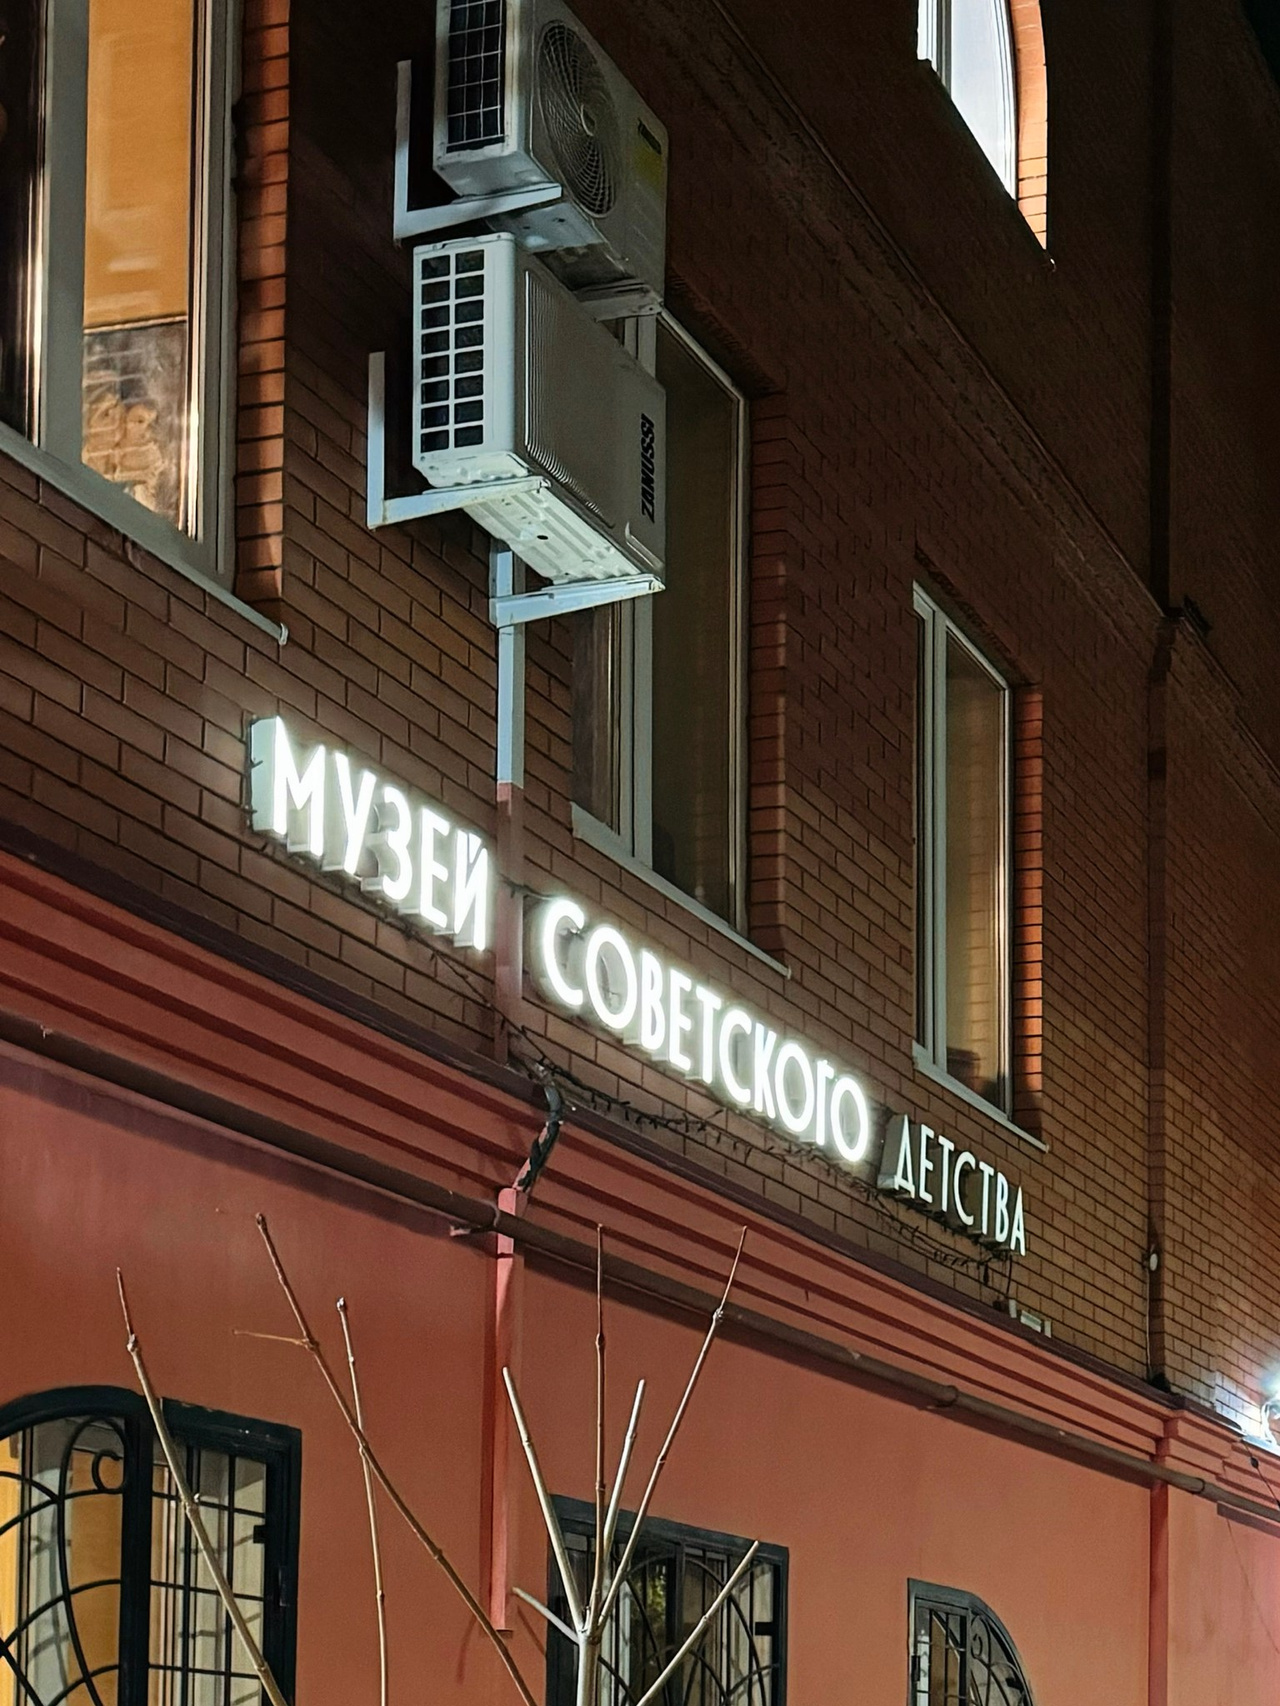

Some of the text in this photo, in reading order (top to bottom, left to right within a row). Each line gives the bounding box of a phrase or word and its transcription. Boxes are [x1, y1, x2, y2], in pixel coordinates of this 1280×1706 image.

[640, 413, 655, 523] ZANUSSI
[273, 716, 1026, 1257] МУЗЕЙ СОВЕТСКОГО ДЕТСТВА
